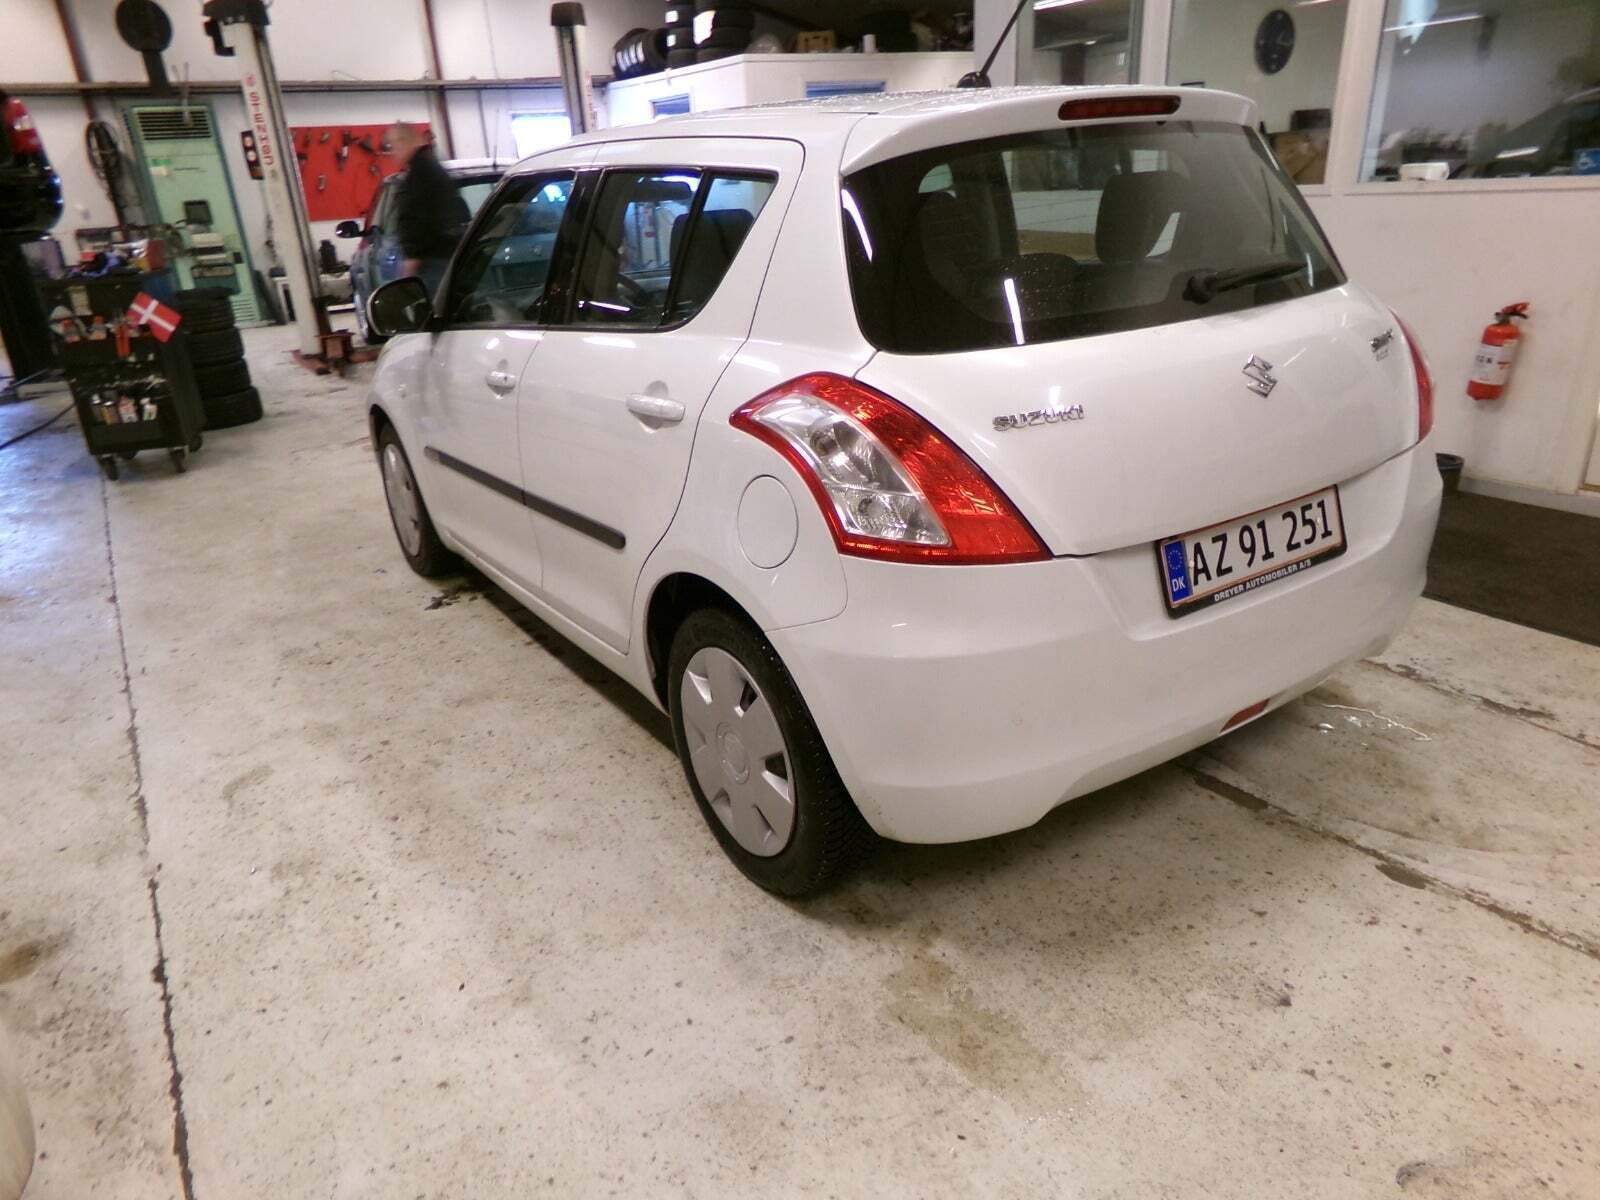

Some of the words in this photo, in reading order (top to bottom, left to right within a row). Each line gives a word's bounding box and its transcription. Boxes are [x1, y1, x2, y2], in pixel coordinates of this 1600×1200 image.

[992, 404, 1084, 432] SUZUKI
[1193, 532, 1233, 586] AZ
[1238, 519, 1275, 568] 91
[1281, 499, 1333, 552] 251
[1171, 575, 1187, 592] DK
[1213, 583, 1245, 602] DREYER
[1245, 562, 1299, 591] AUTOMOBILER
